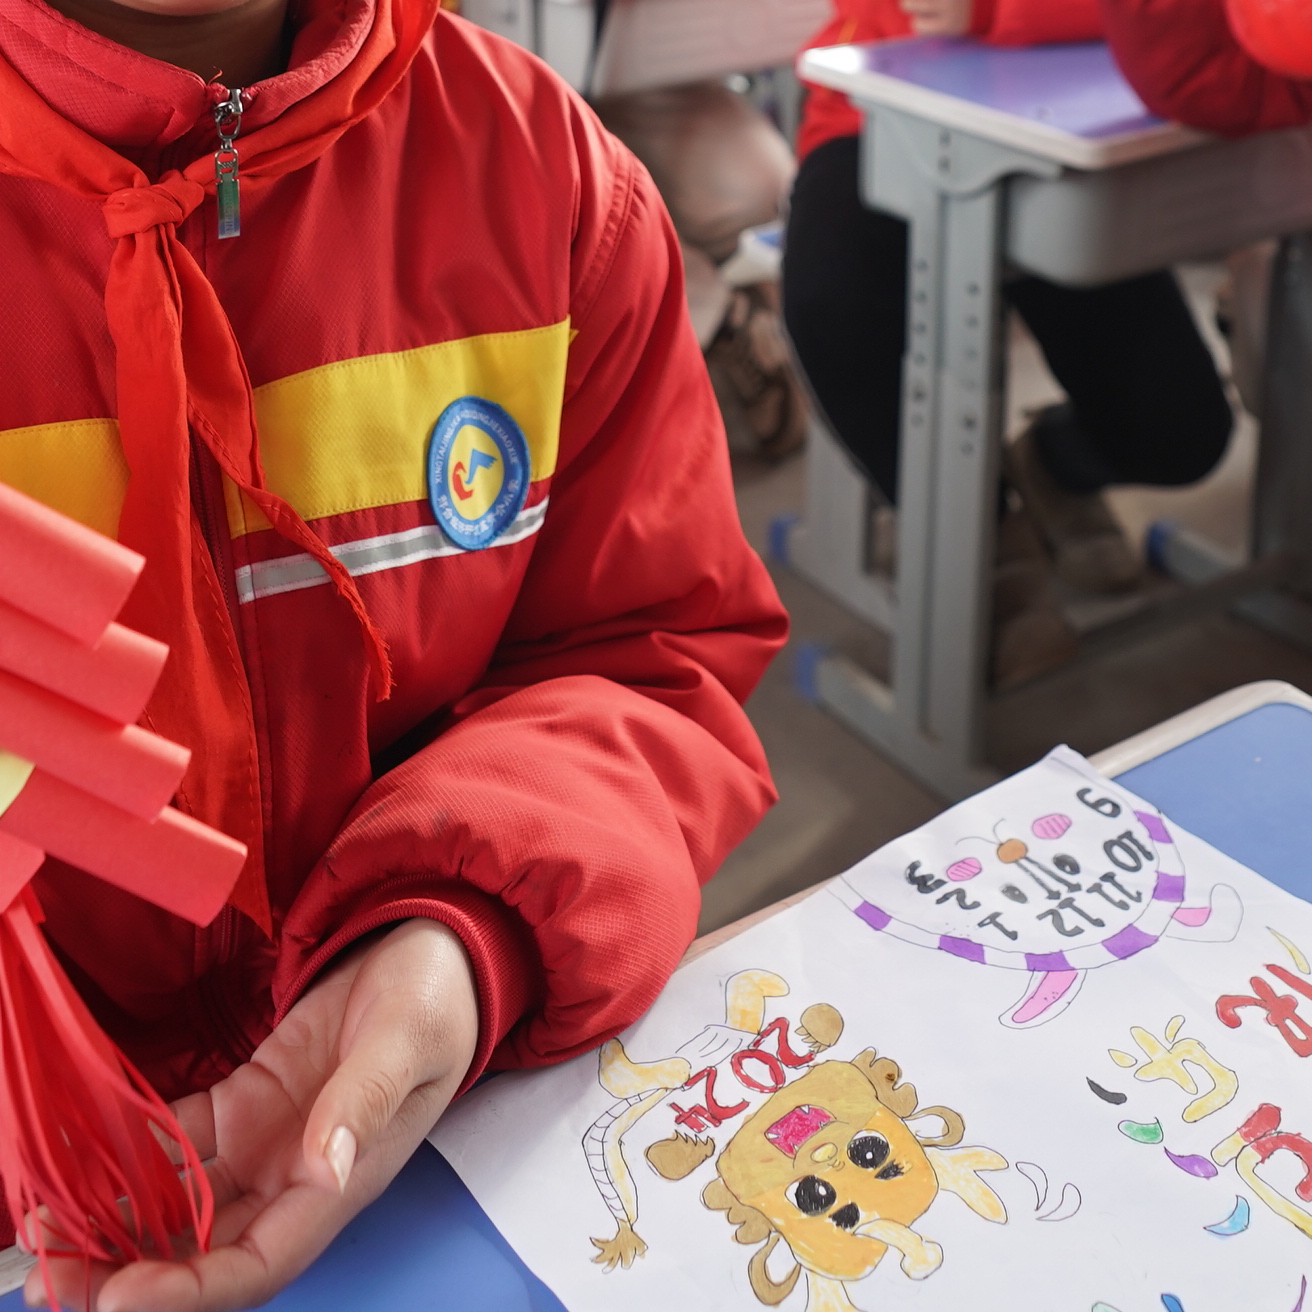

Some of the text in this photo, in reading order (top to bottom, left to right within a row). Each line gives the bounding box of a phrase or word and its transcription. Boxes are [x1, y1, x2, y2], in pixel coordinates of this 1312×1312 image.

[1076, 787, 1122, 818] 9
[1103, 830, 1154, 872] 10
[904, 860, 948, 894] 3
[1086, 872, 1142, 911] 11
[935, 888, 981, 910] 2
[1036, 897, 1105, 937] 12
[977, 911, 1018, 941] 1
[668, 1017, 815, 1133] 2024
